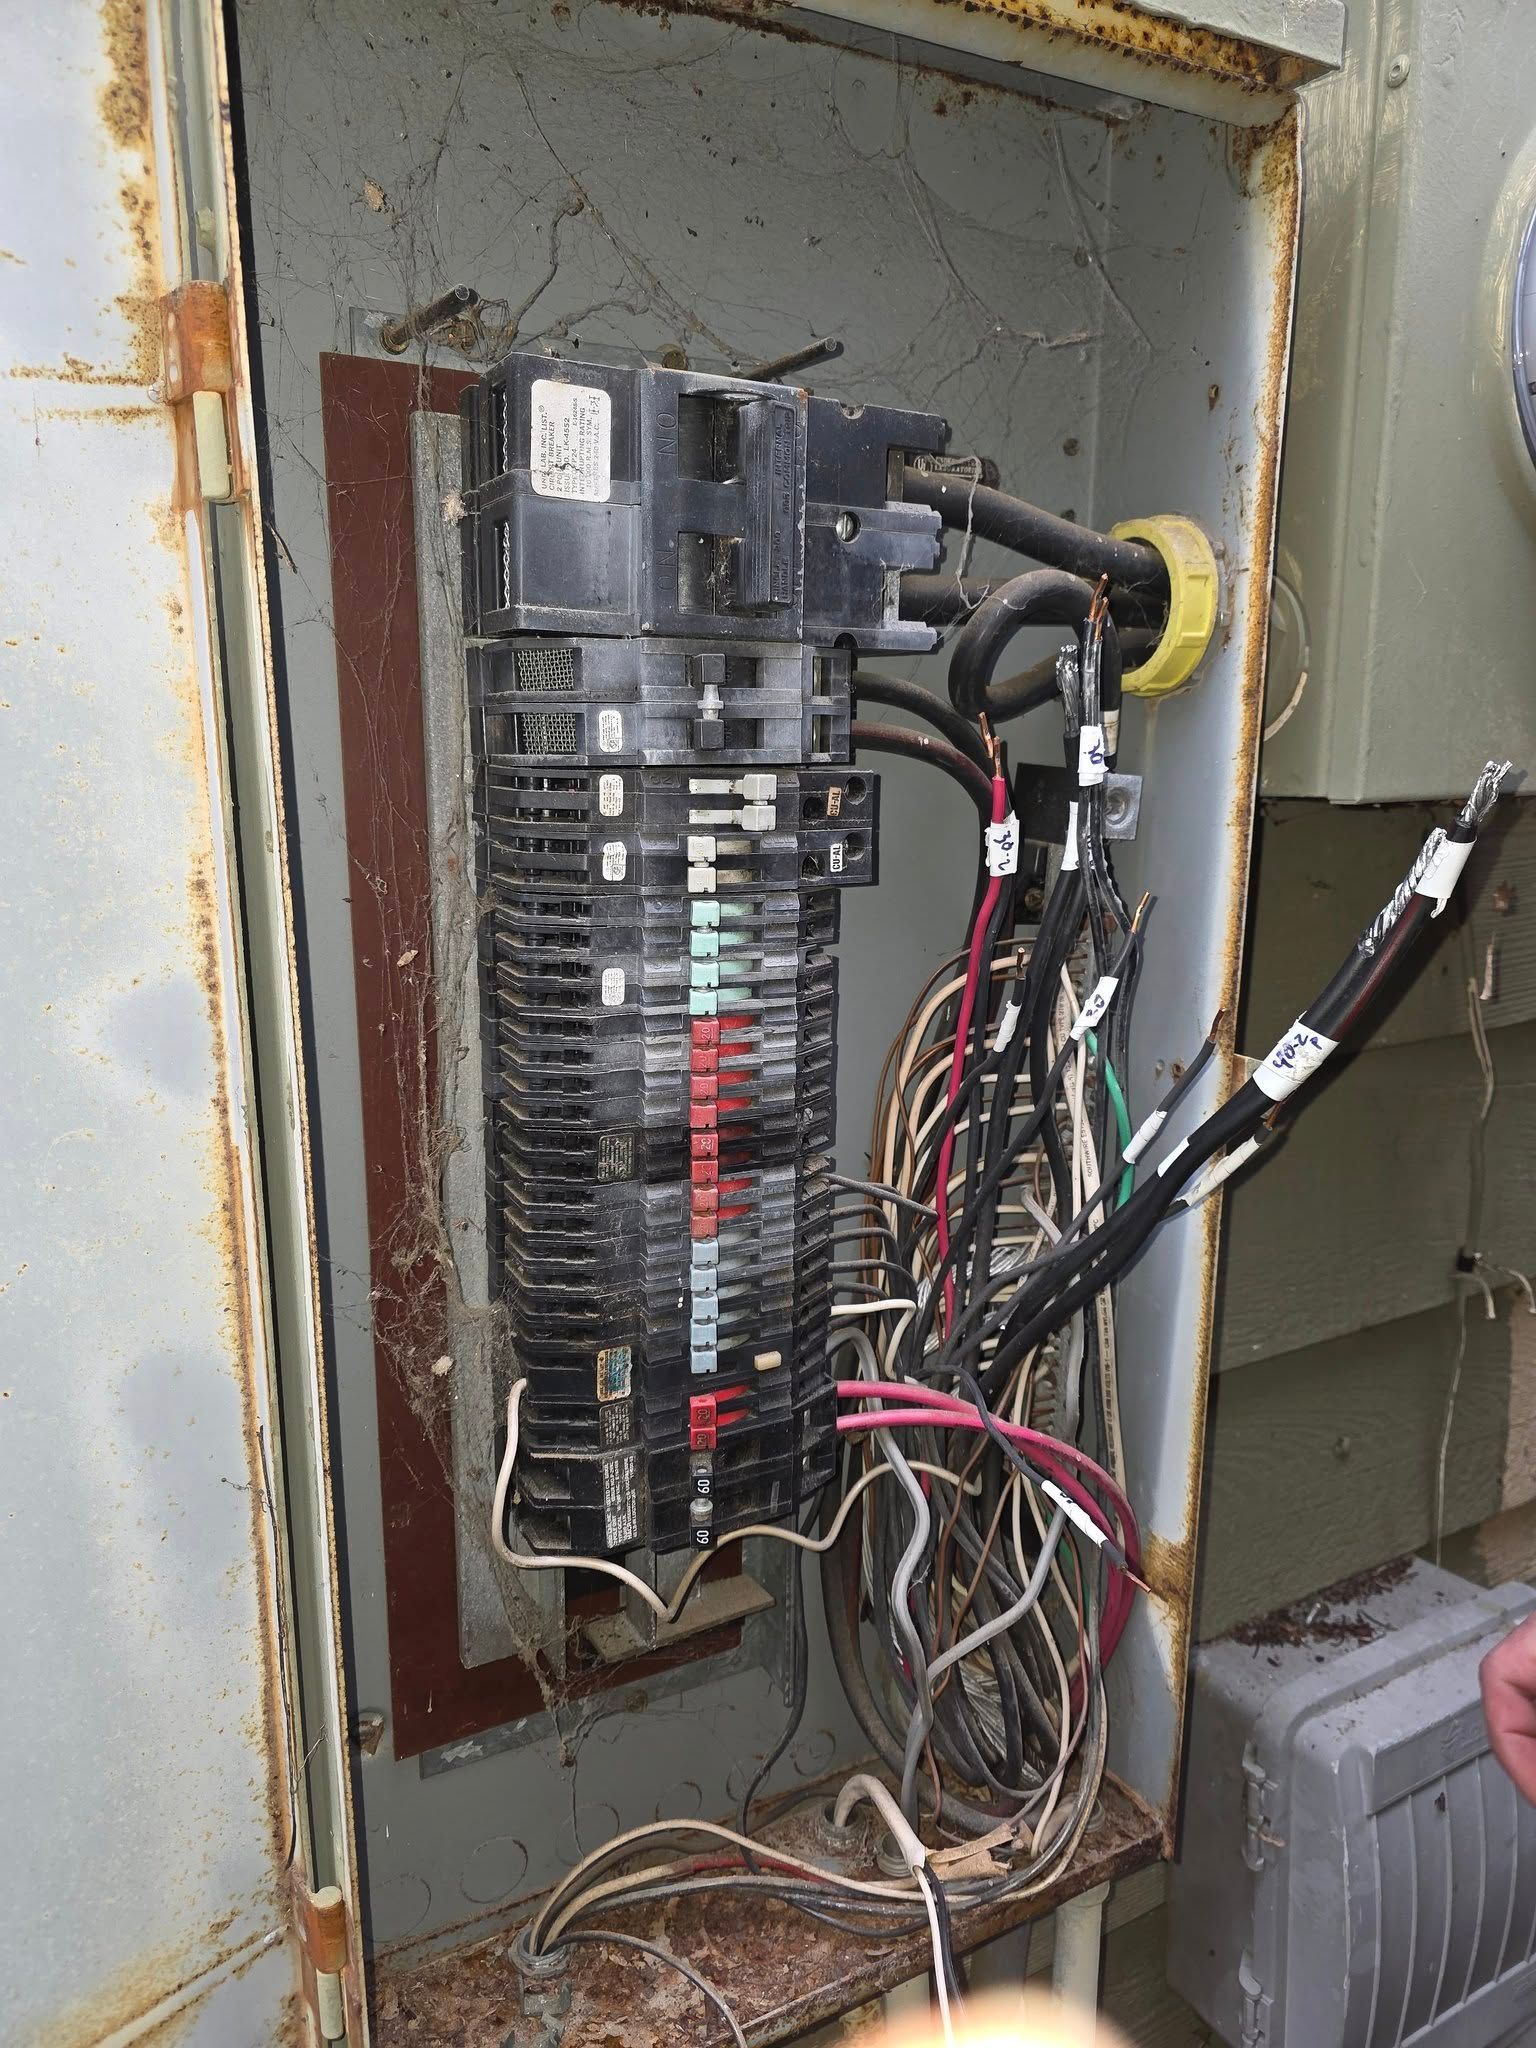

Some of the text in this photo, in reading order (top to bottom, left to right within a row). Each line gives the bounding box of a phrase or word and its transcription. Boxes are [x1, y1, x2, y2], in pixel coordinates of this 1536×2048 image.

[829, 790, 841, 816] CU-AL
[831, 846, 843, 871] CU-AL
[702, 1028, 710, 1039] 20
[697, 1434, 706, 1445] 20
[697, 1478, 710, 1494] 60
[696, 1529, 709, 1545] 60
